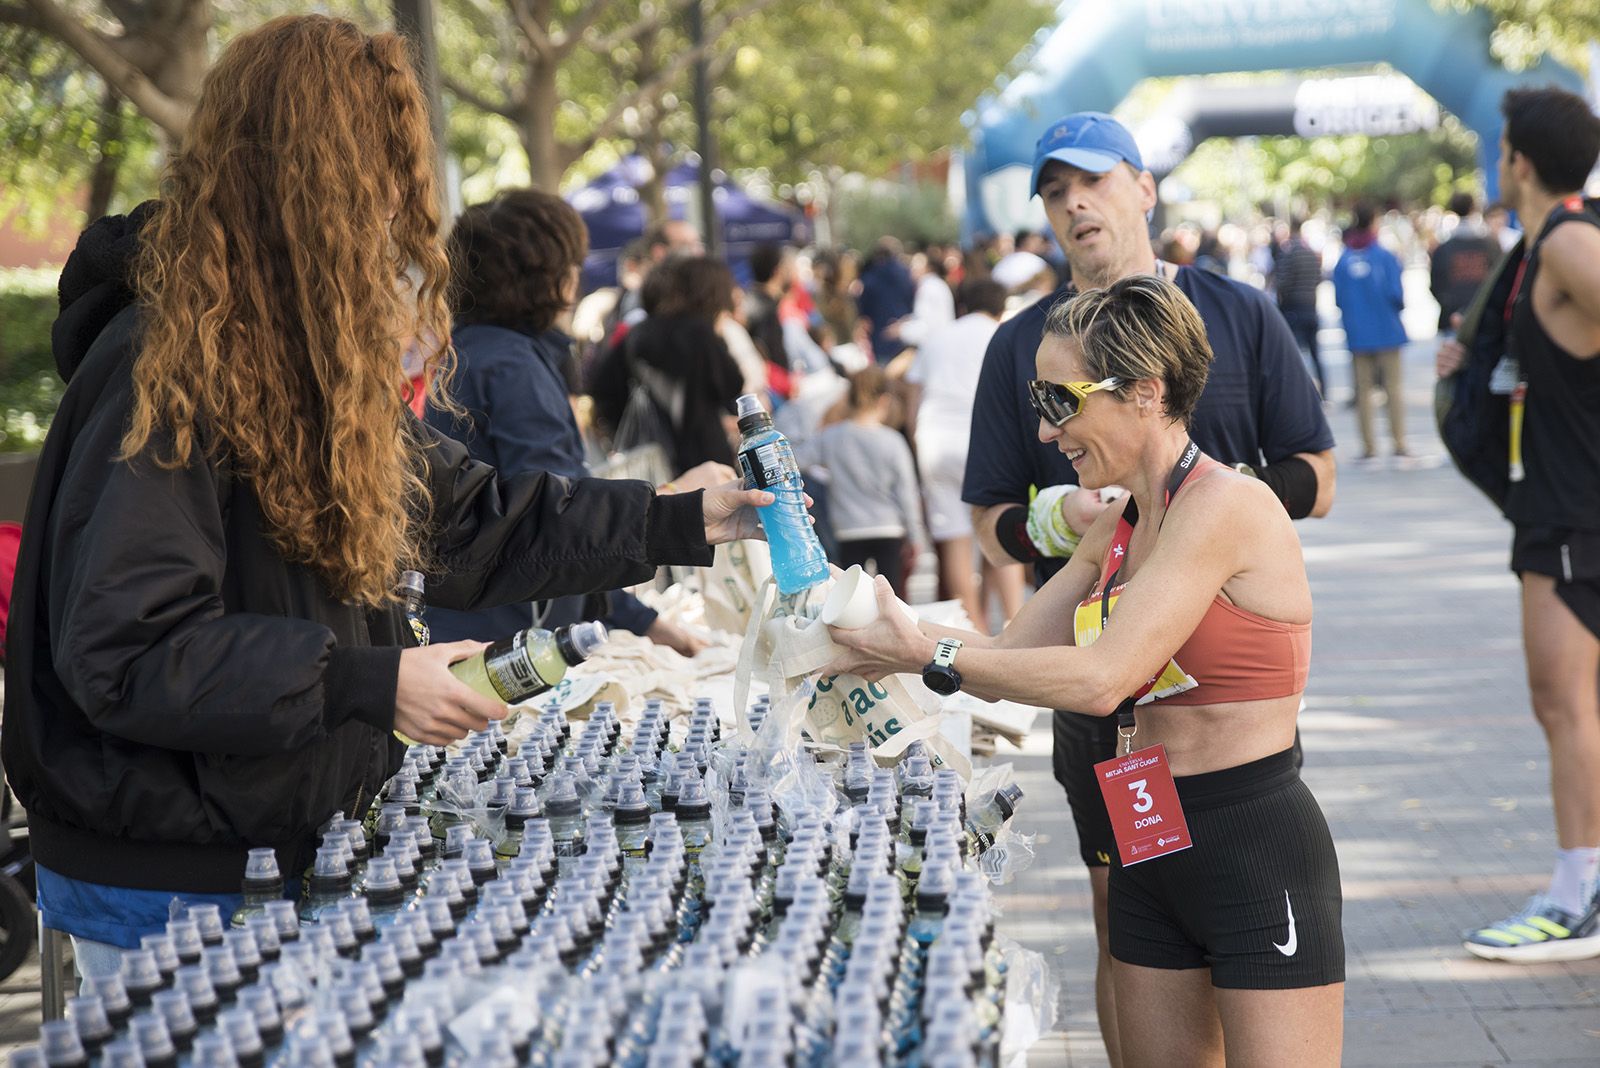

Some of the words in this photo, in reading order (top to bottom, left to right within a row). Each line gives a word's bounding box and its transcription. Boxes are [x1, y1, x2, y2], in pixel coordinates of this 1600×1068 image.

[1180, 443, 1199, 469] SPORTS
[1105, 769, 1123, 778] MITJA
[1123, 764, 1139, 772] SANT
[1139, 756, 1159, 768] CUGAT
[1128, 779, 1153, 813] 3
[1135, 814, 1163, 830] DONA
